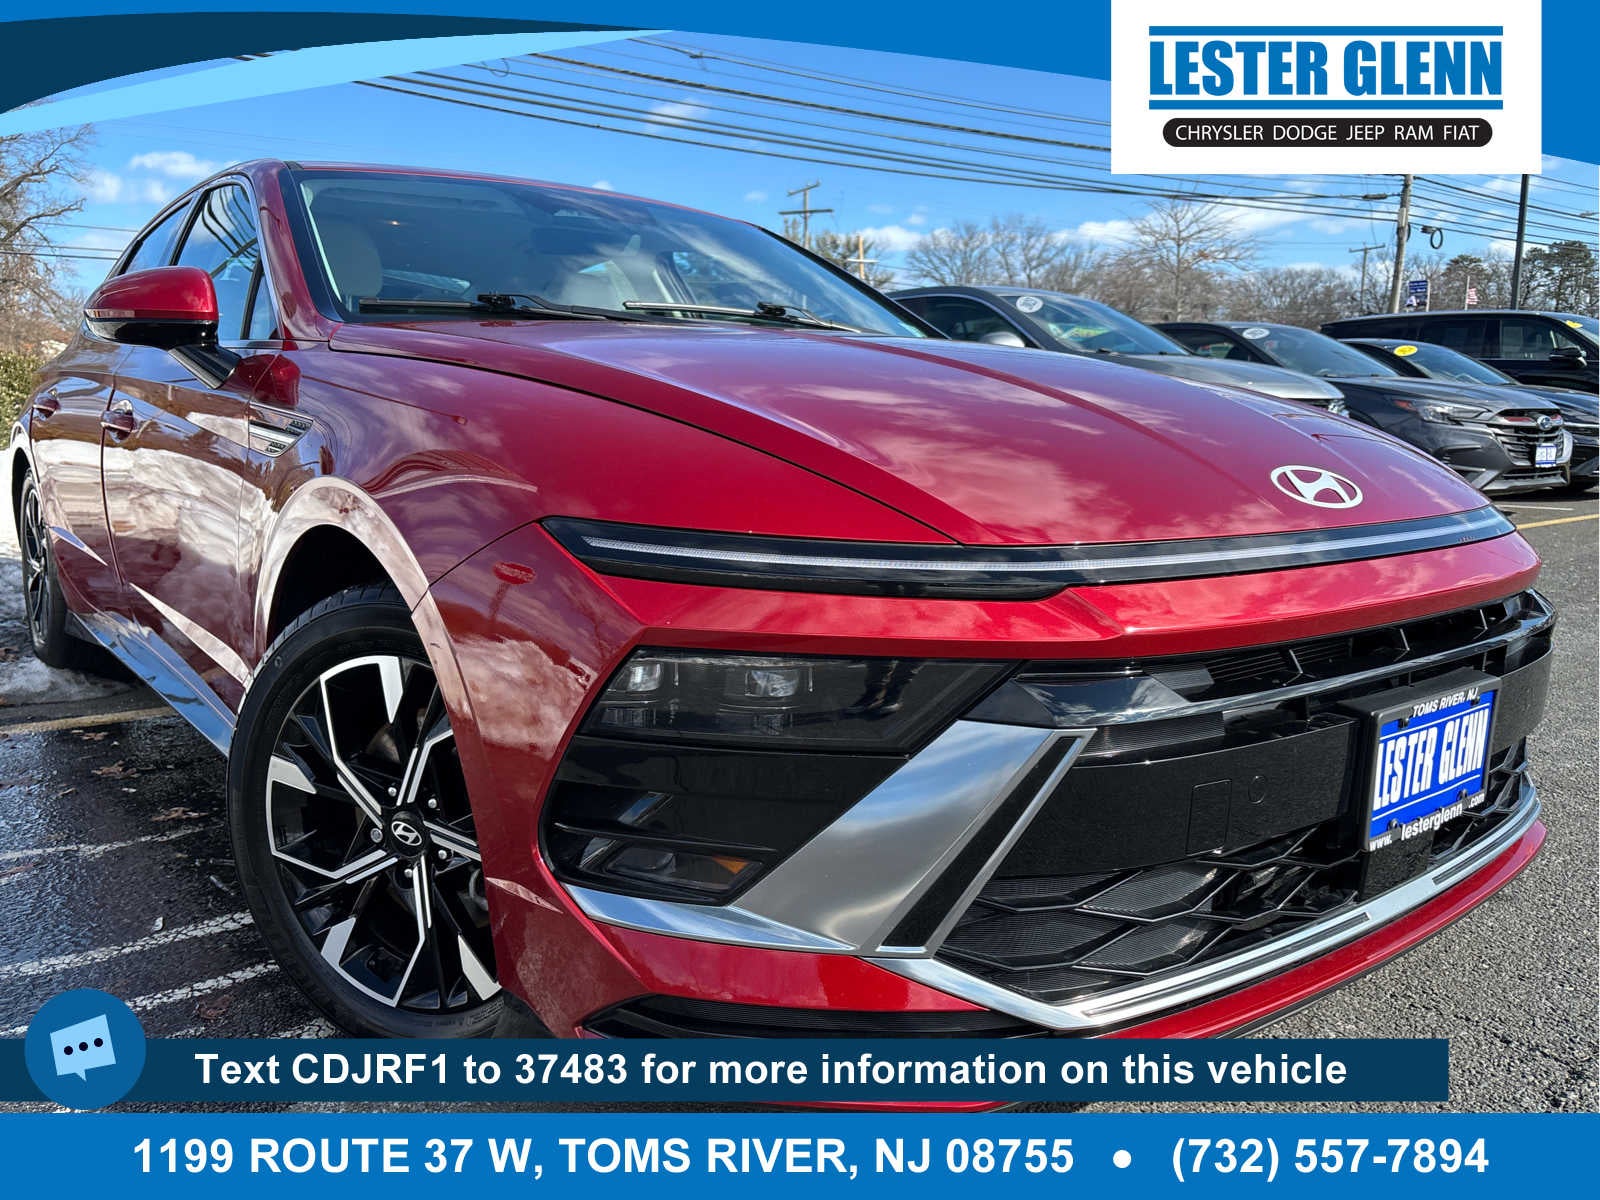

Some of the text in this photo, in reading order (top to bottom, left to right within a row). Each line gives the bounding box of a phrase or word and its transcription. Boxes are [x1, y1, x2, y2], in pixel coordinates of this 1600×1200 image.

[1412, 701, 1438, 718] TOMS
[1373, 708, 1490, 811] LESTER GLENN
[1400, 802, 1463, 841] lesterglenn
